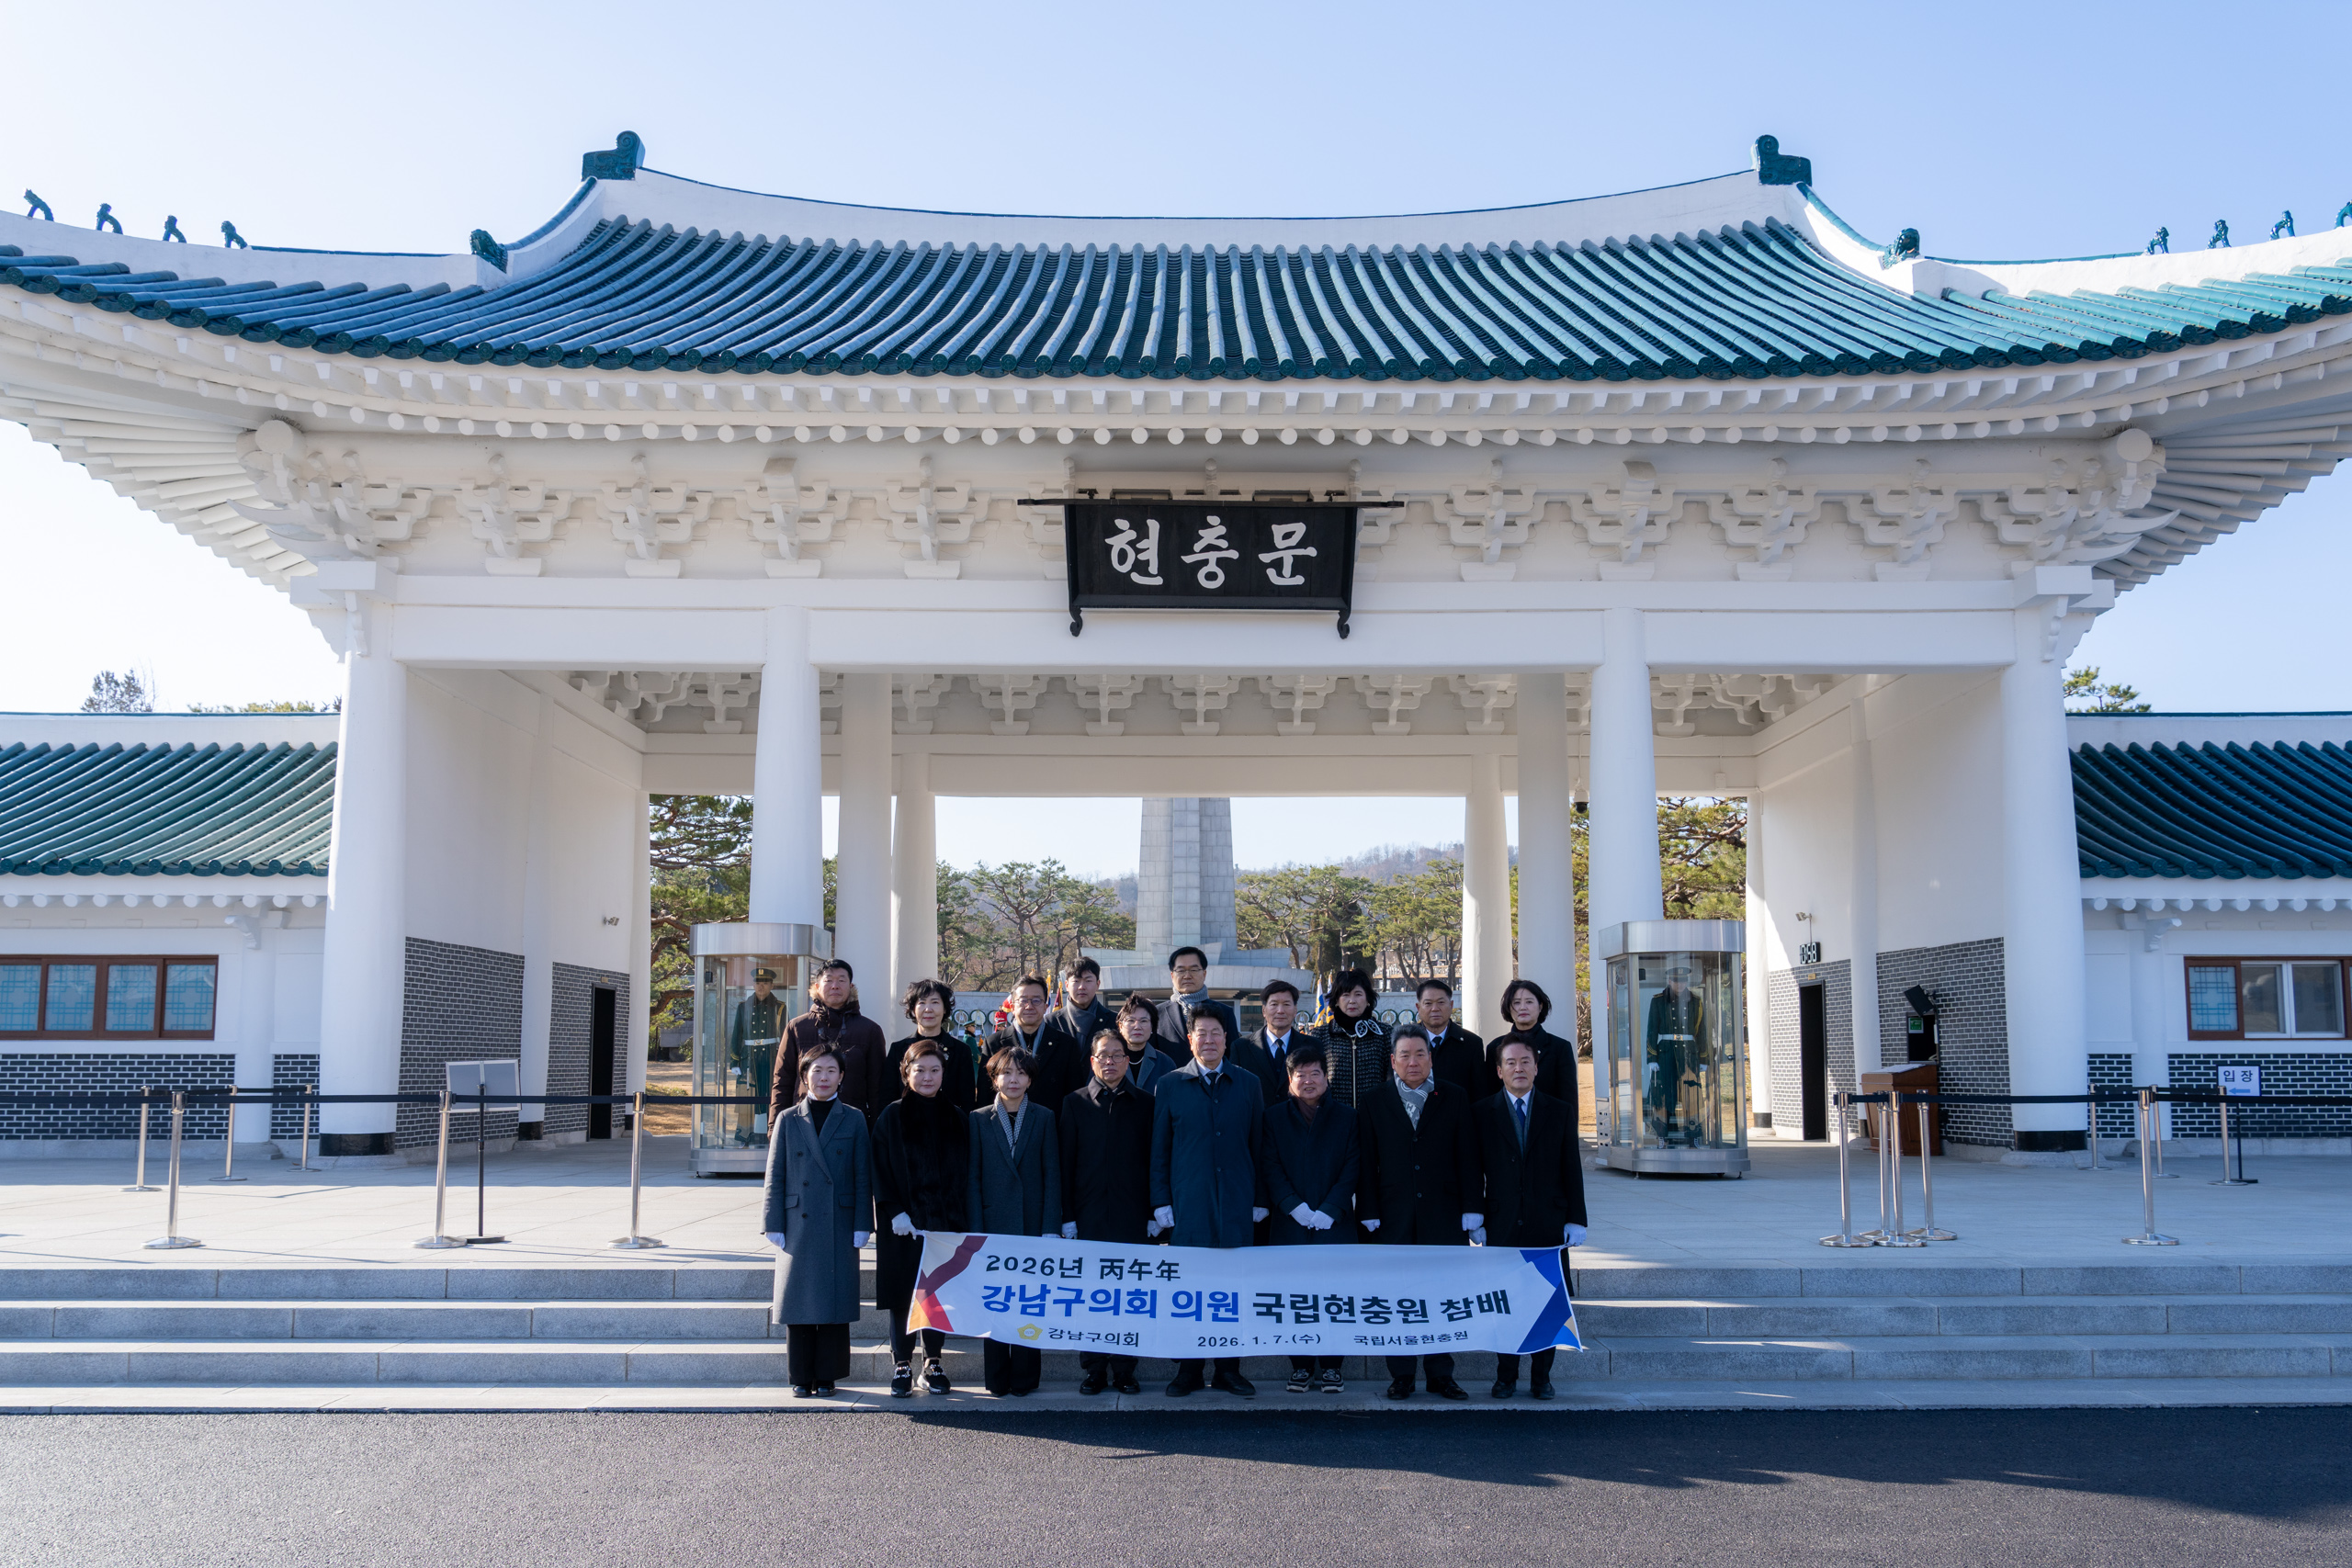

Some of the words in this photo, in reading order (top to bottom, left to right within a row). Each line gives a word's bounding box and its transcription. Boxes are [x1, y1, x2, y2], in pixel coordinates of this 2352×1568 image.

[1105, 515, 1317, 590] 현충문
[986, 1255, 1083, 1279] 2026년
[1099, 1258, 1182, 1282] 丙午年
[981, 1283, 1158, 1319] 강남구의회
[1170, 1290, 1239, 1323] 의원
[1252, 1292, 1430, 1325] 국립현충원
[1440, 1289, 1511, 1323] 참배
[1048, 1327, 1139, 1348] 강남구의회
[1353, 1330, 1468, 1347] 국립서울현충원
